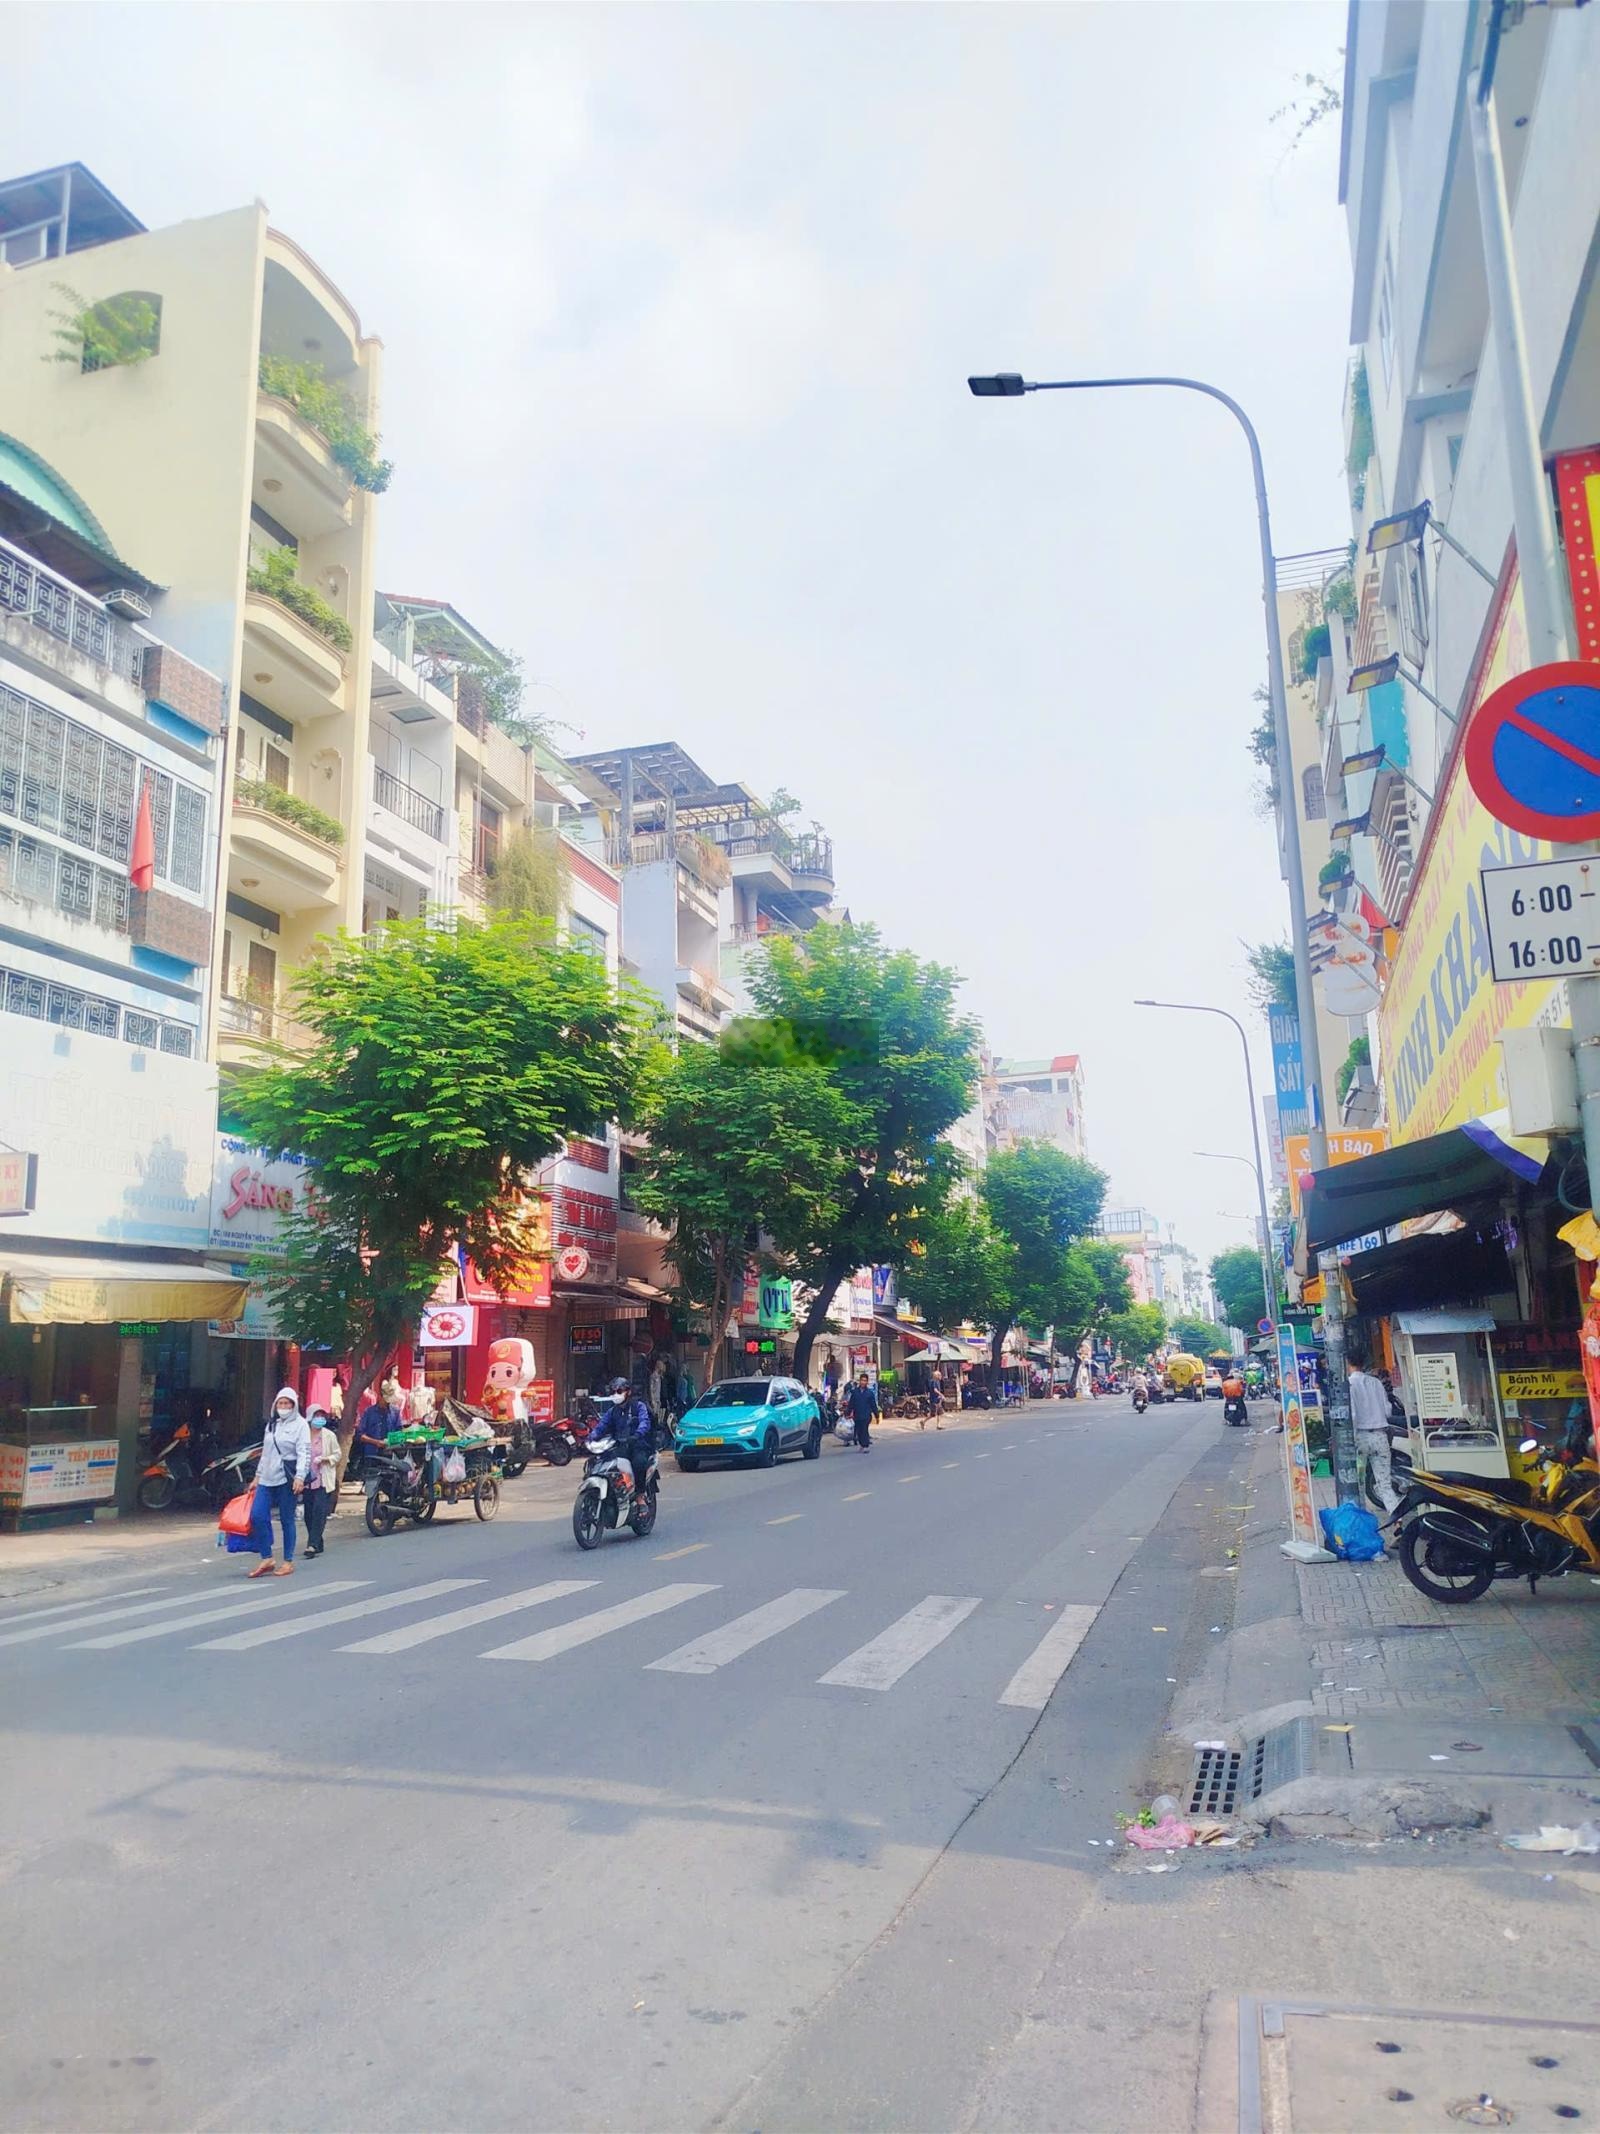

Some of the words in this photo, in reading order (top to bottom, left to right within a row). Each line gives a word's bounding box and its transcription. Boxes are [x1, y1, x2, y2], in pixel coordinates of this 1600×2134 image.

[1511, 884, 1573, 917] 6:00
[1509, 935, 1582, 969] 16:00
[1392, 994, 1434, 1131] MINH
[1343, 1139, 1373, 1157] BAO
[223, 1166, 293, 1220] SÁNG
[1360, 1236, 1377, 1250] 169
[1505, 1385, 1561, 1396] Chay
[1508, 1374, 1538, 1384] Bánh
